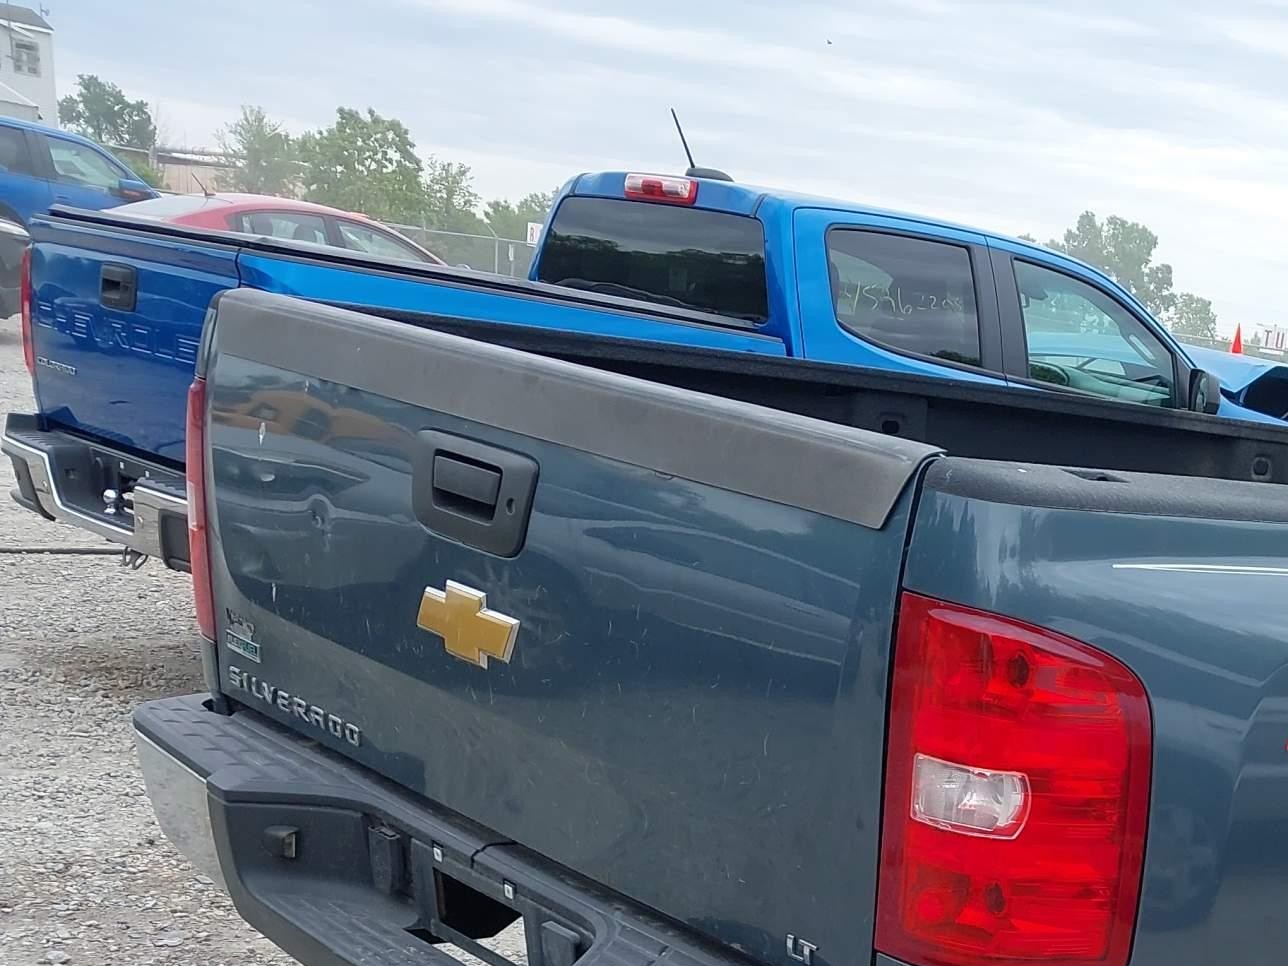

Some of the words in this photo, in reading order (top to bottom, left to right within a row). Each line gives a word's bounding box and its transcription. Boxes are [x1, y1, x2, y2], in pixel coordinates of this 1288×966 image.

[37, 301, 200, 365] CHEVROLE
[228, 665, 361, 747] SILVERADO
[786, 934, 818, 966] LT
